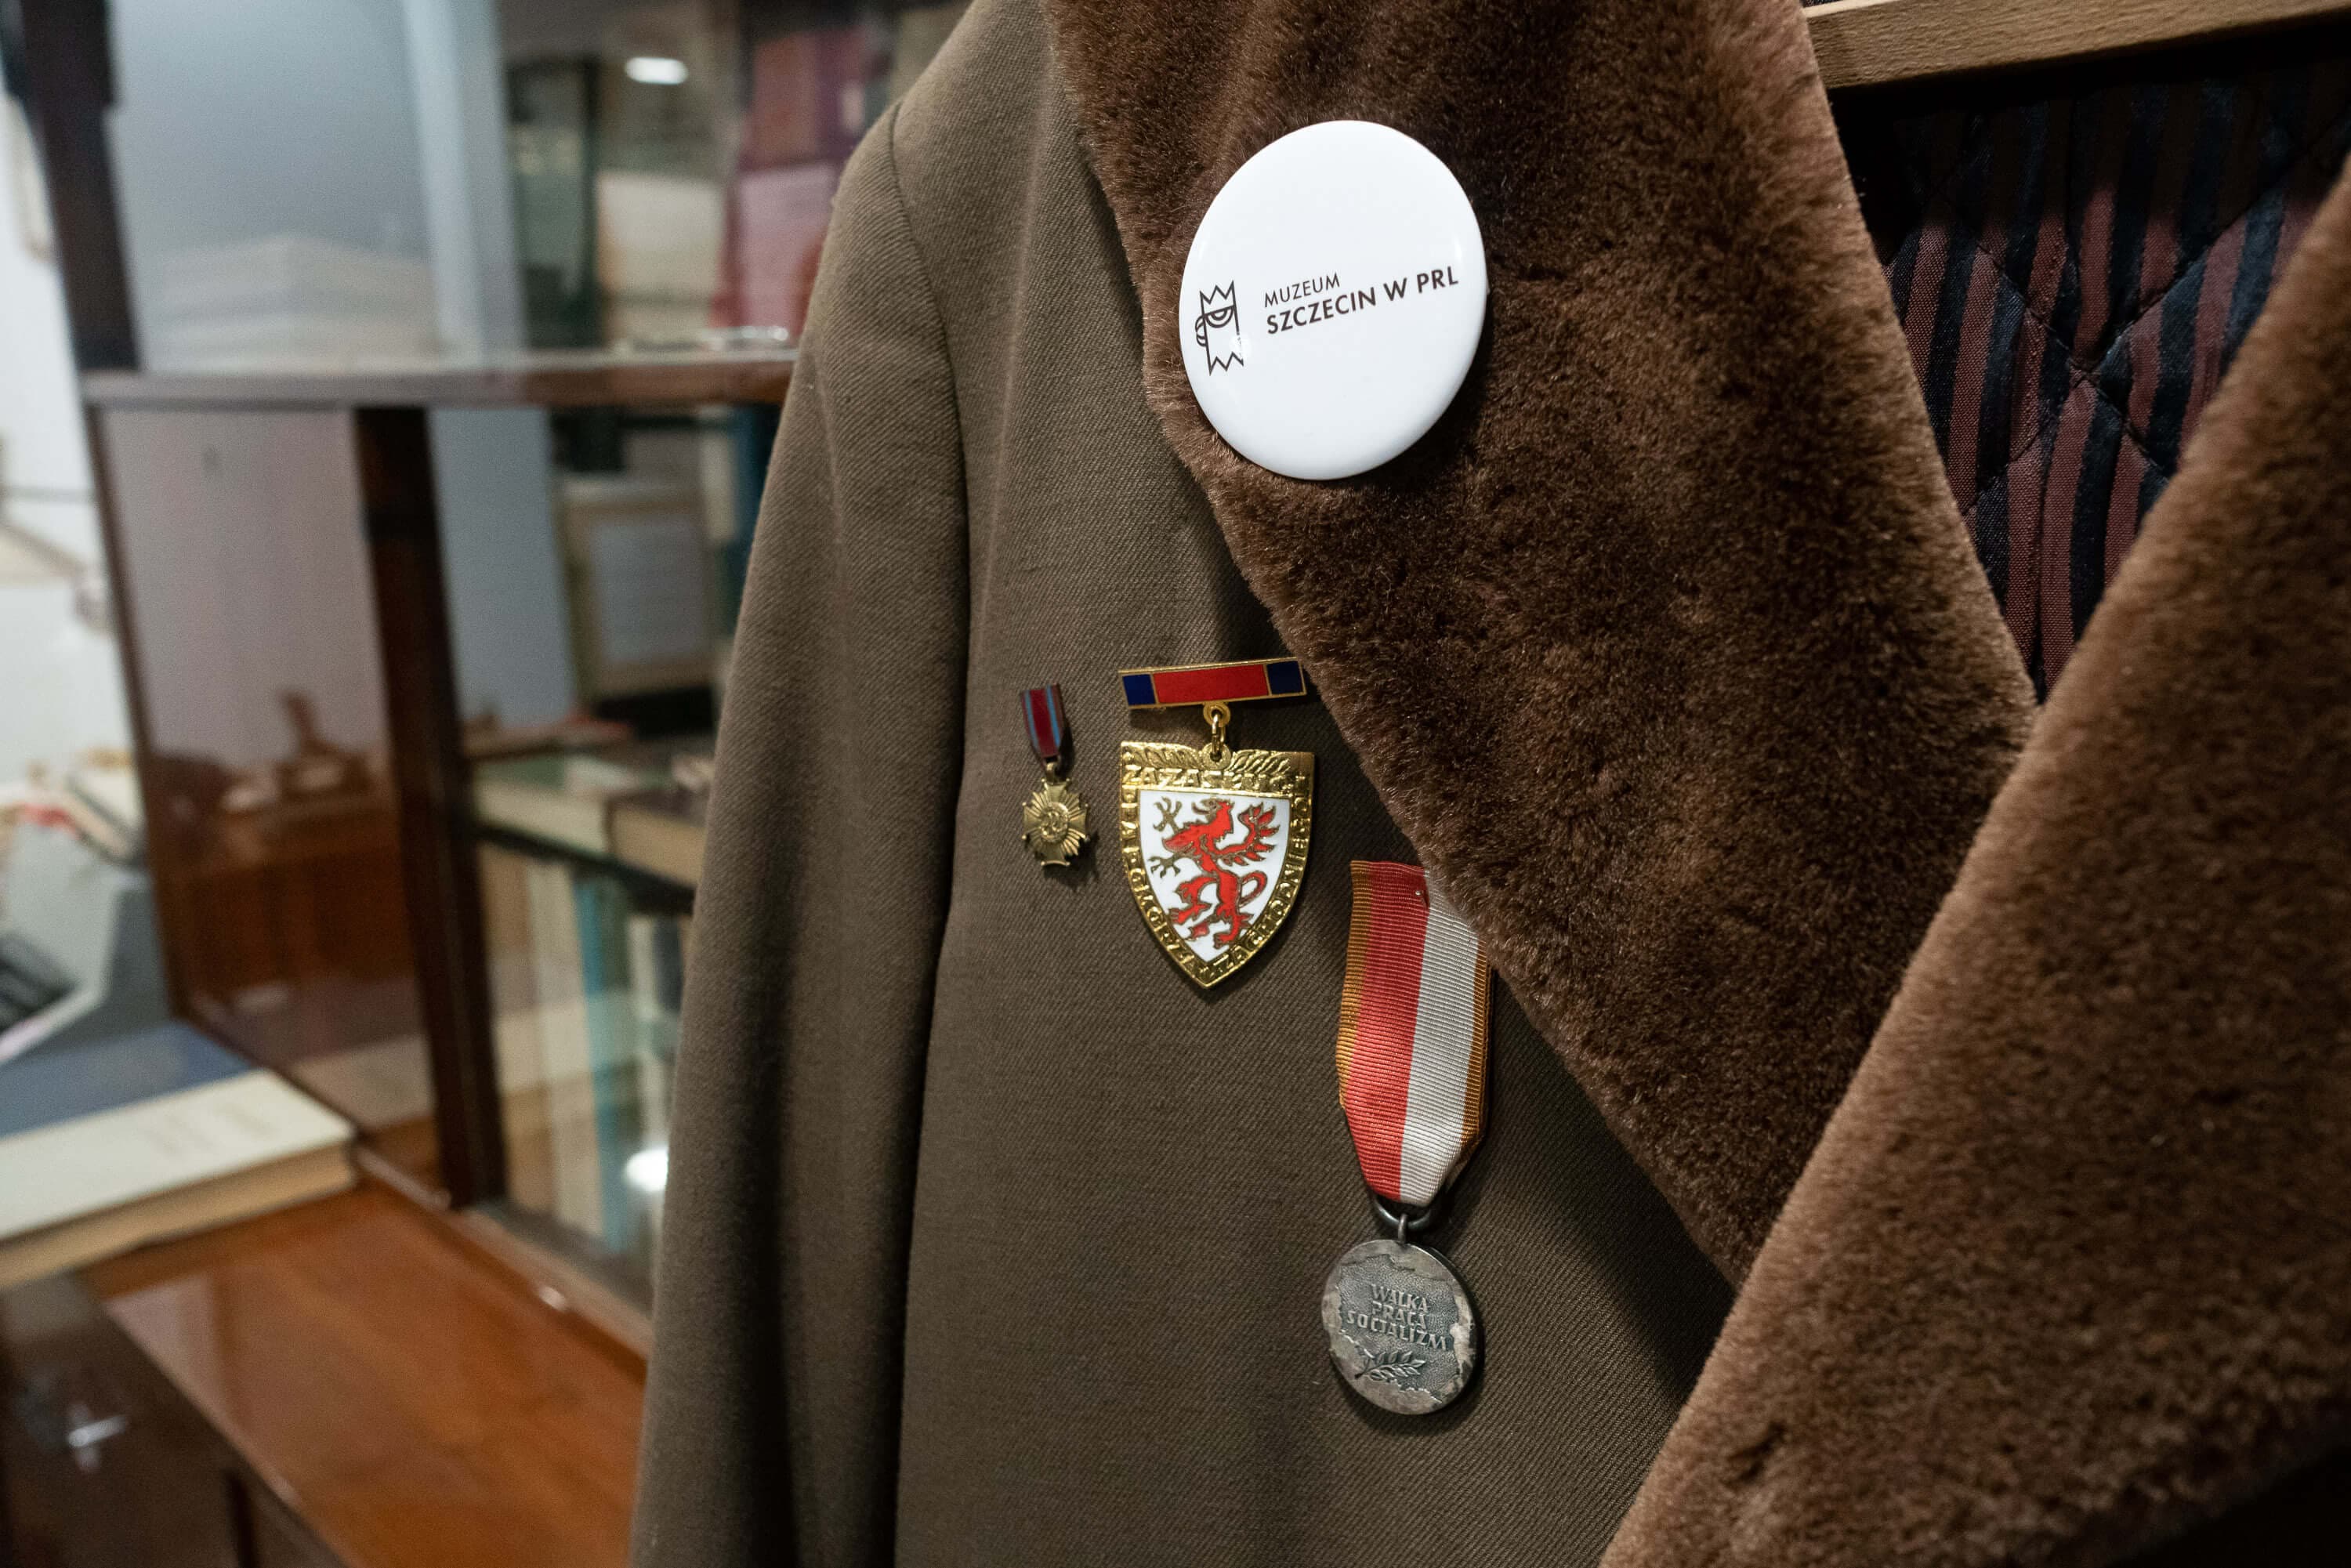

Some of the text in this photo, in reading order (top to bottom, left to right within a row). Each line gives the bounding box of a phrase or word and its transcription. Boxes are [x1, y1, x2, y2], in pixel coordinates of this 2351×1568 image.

[1264, 273, 1340, 308] MUZEUM
[1266, 266, 1458, 334] SZCZECIN W PRL
[1371, 1284, 1428, 1313] WALKA
[1372, 1301, 1427, 1330] PRACA
[1346, 1310, 1447, 1350] SOCJALIZM
